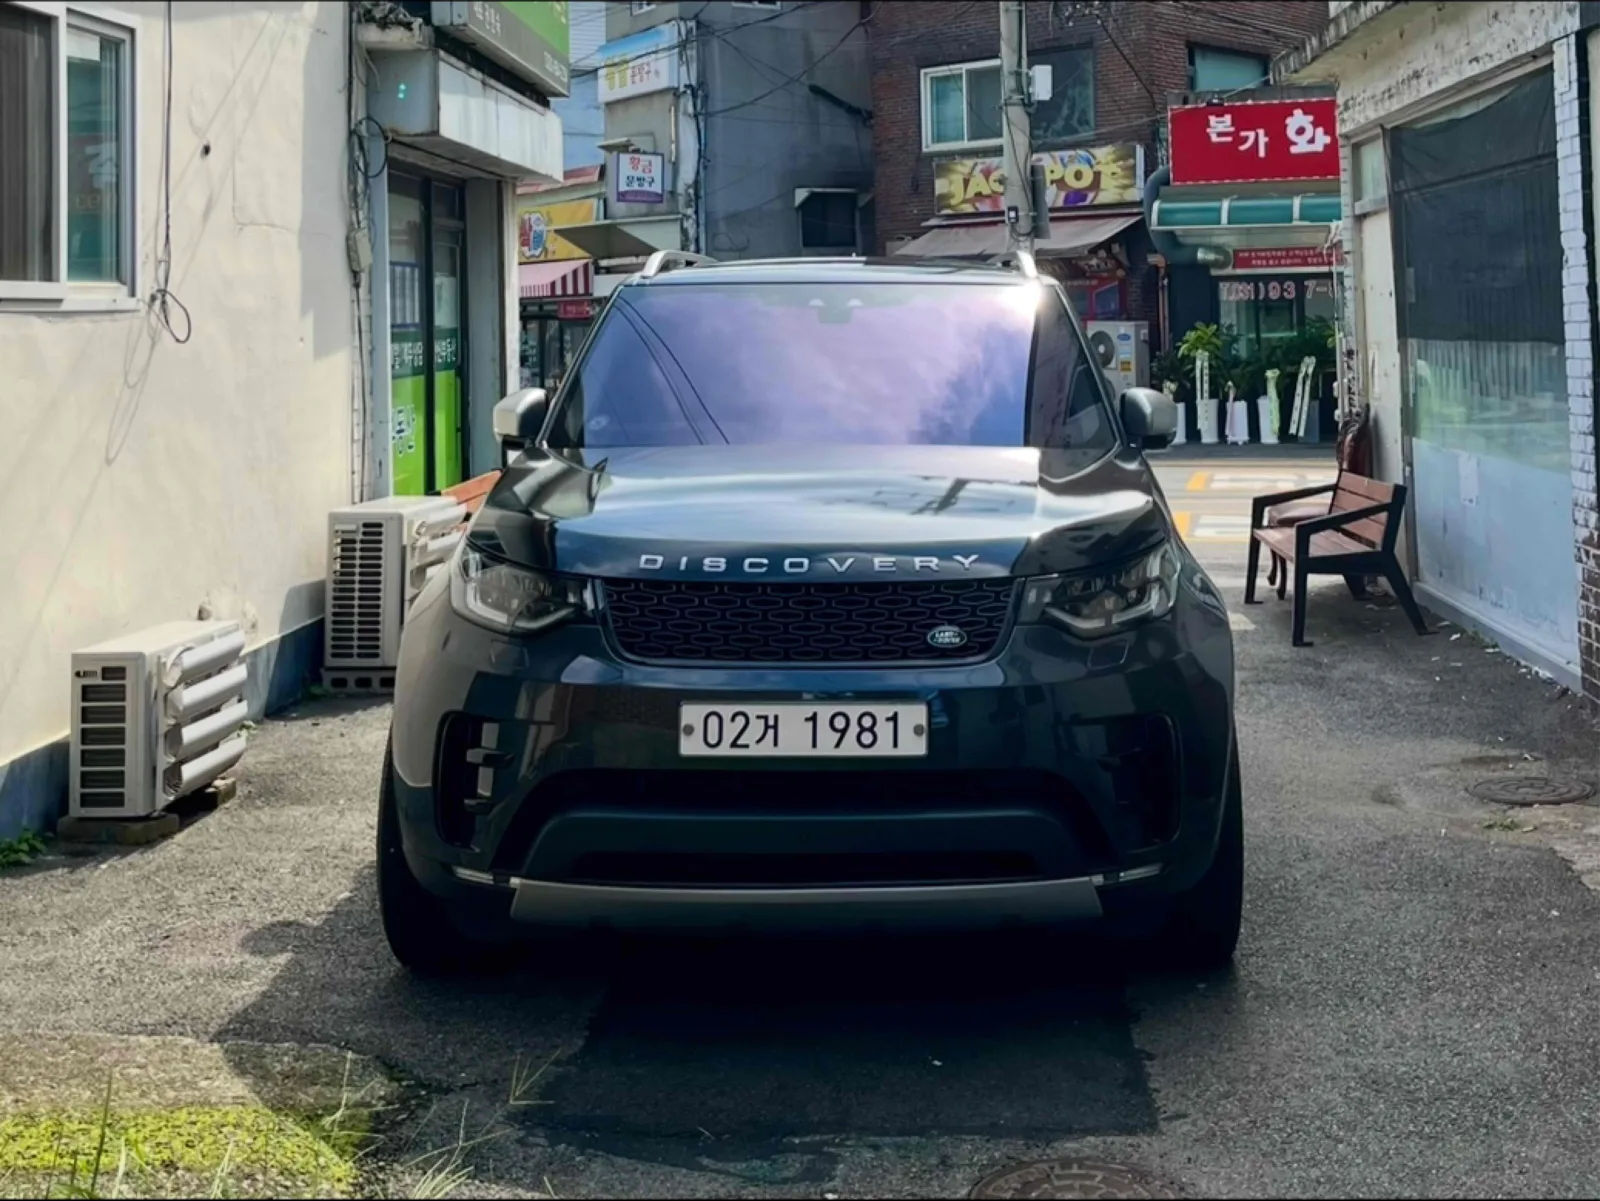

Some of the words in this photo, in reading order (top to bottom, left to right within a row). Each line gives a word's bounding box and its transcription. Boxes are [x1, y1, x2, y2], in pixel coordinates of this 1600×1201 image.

[1206, 113, 1269, 158] 본가
[629, 155, 653, 174] 황금
[625, 175, 655, 188] 문방구
[948, 160, 1122, 206] JACPOT
[638, 553, 979, 573] DISCOVERY
[702, 710, 779, 749] 02거
[804, 711, 898, 749] 1981
